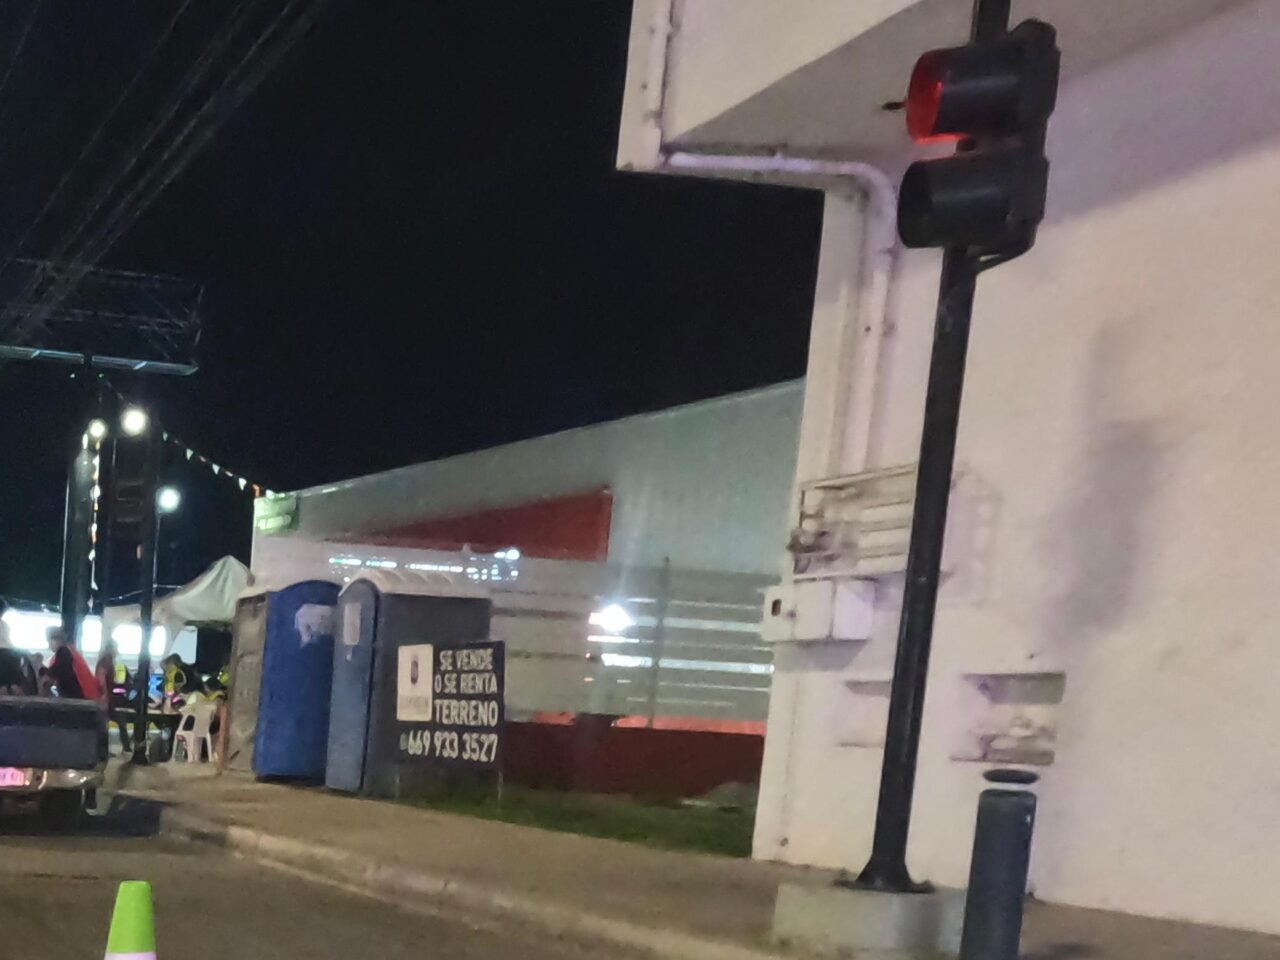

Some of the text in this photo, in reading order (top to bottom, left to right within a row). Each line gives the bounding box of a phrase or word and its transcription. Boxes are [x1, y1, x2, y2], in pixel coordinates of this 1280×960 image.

[439, 648, 494, 671] SE VENDE
[434, 671, 498, 695] O SE RENTA
[434, 698, 499, 727] TERRENO
[407, 729, 498, 763] 669 933 3527
